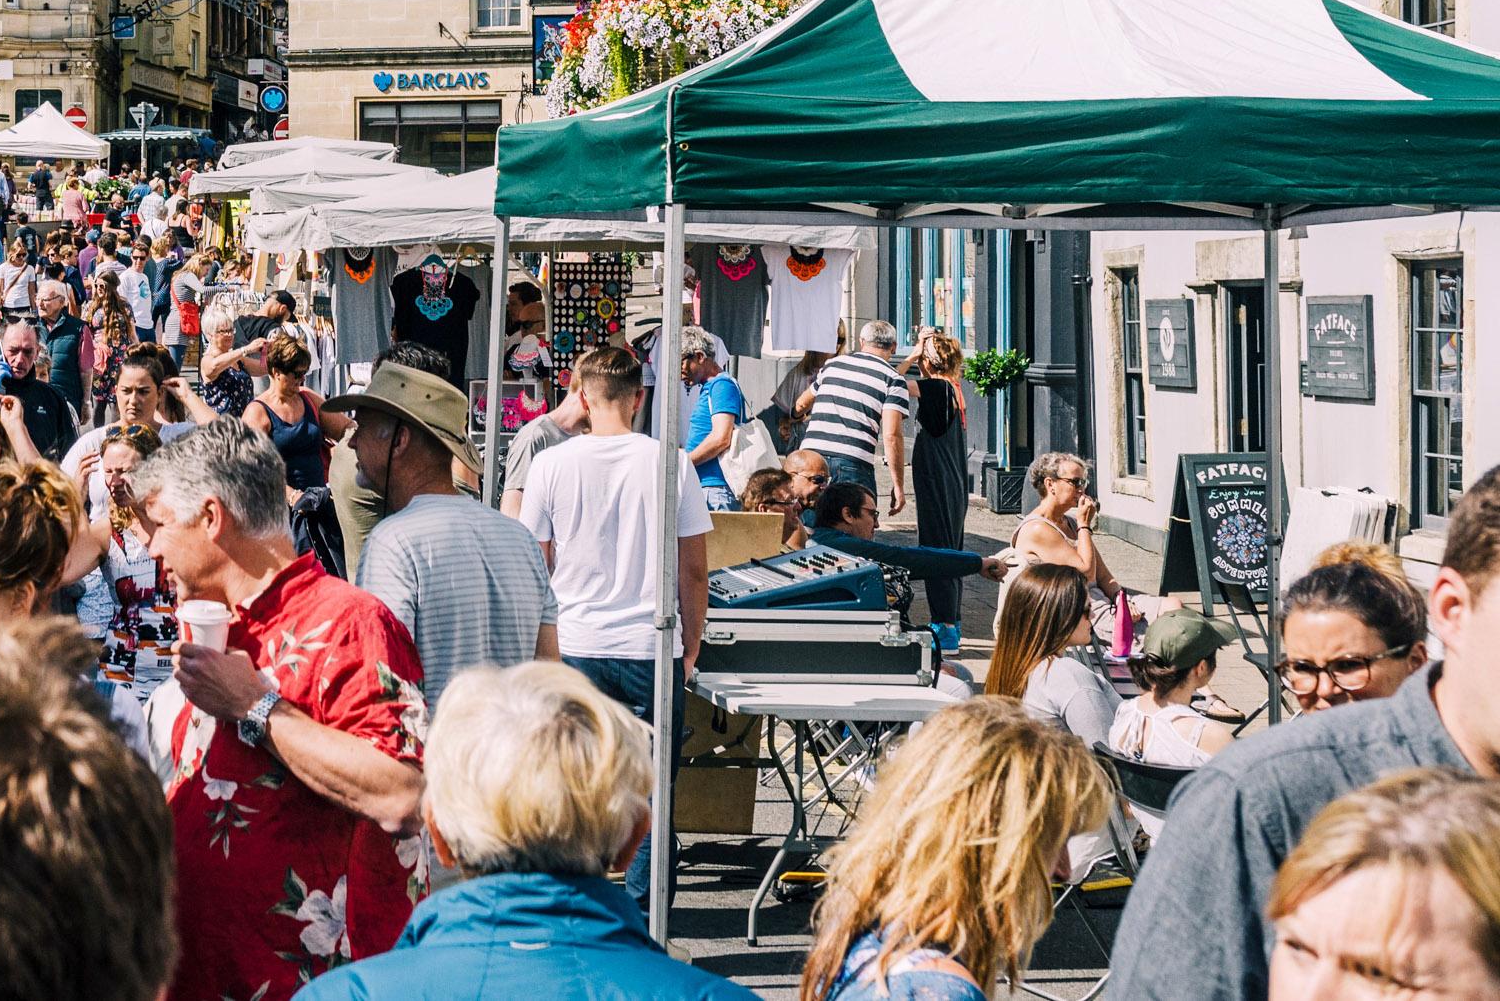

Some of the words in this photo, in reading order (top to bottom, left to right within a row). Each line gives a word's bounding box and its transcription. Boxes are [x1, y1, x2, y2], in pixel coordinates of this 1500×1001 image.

[397, 72, 489, 88] BARCLAYS
[1314, 313, 1357, 342] FATFACE
[1196, 463, 1267, 484] FATFAC
[1208, 489, 1240, 500] Enjoy
[1243, 488, 1265, 497] Your
[1212, 556, 1268, 579] ADVENTUR
